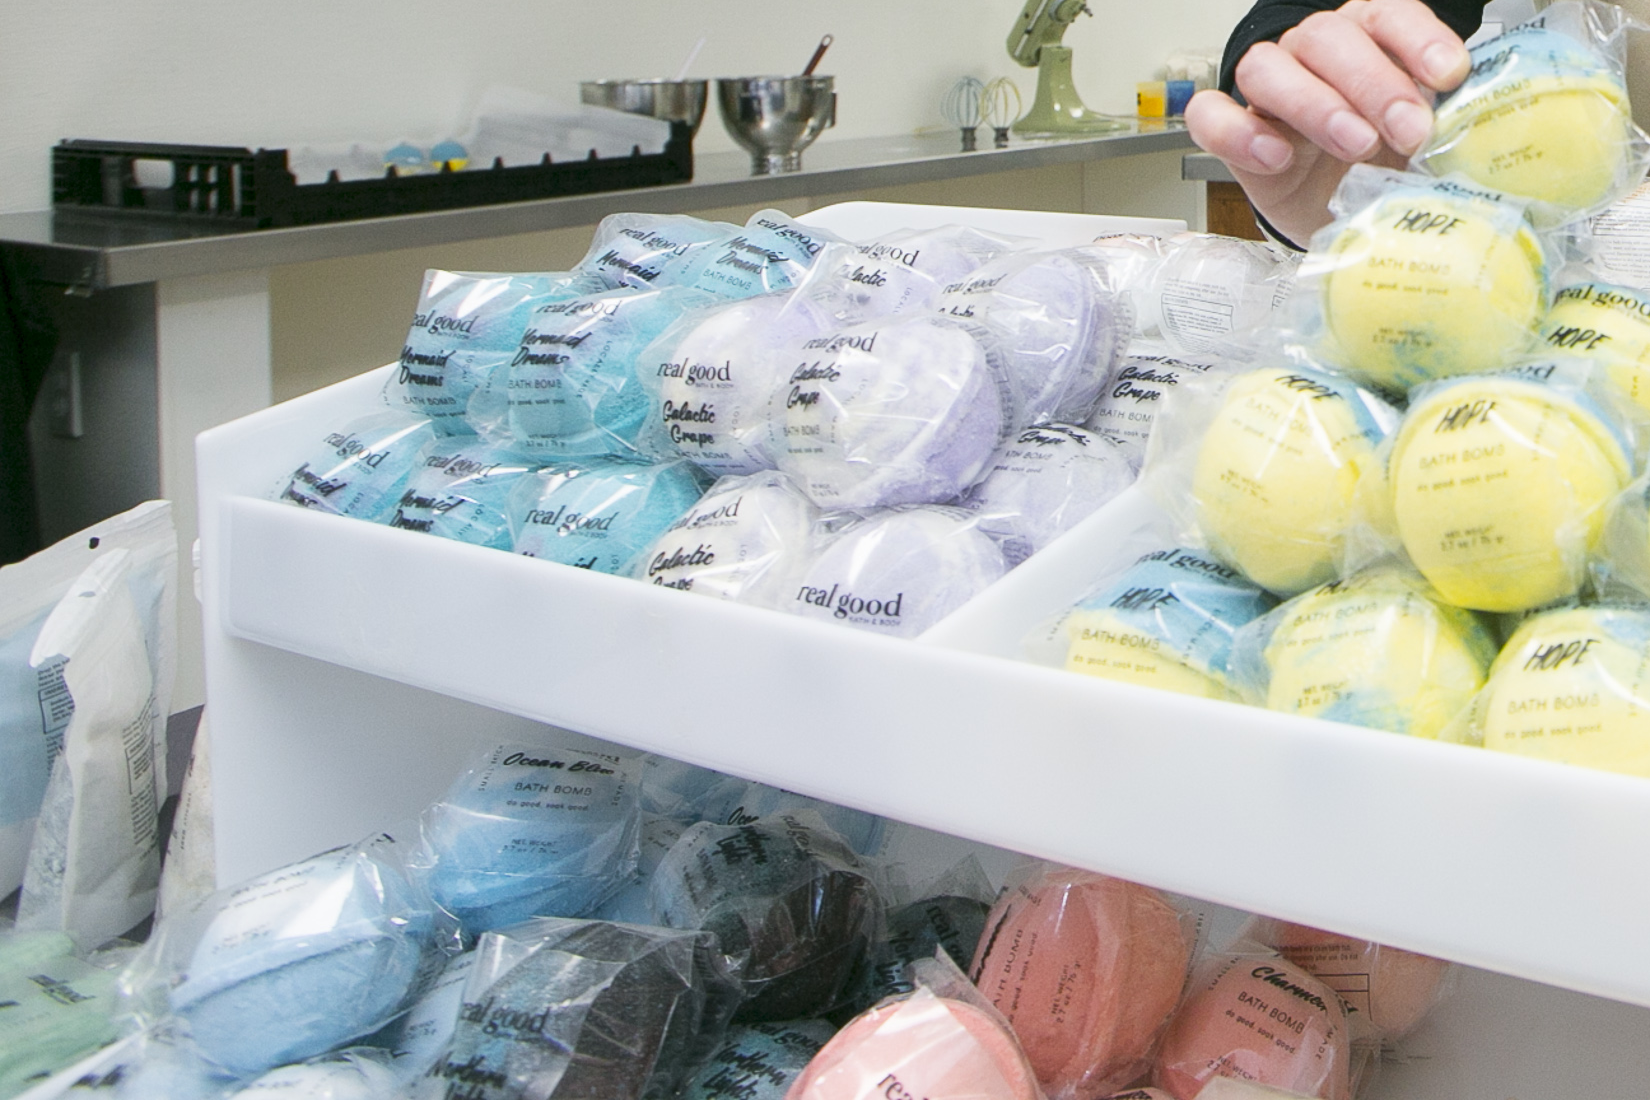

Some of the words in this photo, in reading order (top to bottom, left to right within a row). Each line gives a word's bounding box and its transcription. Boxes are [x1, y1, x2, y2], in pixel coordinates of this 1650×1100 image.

[1393, 208, 1467, 236] HOPE
[1368, 255, 1404, 272] BATH
[1408, 256, 1451, 275] BOMB
[702, 269, 724, 283] BATH
[725, 275, 753, 292] BOMB
[1551, 284, 1595, 311] real
[427, 314, 481, 334] good
[1547, 325, 1612, 350] HOPE
[510, 347, 570, 368] Dreams
[399, 365, 444, 388] Dreams
[508, 378, 532, 389] BATH
[533, 378, 562, 389] BOMB
[656, 357, 690, 378] real
[684, 359, 732, 386] good
[1117, 365, 1180, 386] Galactic
[1111, 380, 1161, 403] Grape
[662, 399, 716, 425] Galactic
[1099, 408, 1125, 419] BATH
[1128, 412, 1155, 423] BOM
[1434, 399, 1497, 434] HOPE
[670, 423, 715, 448] Grape
[1418, 453, 1457, 470] BATH
[1461, 443, 1506, 462] BOMB
[524, 504, 567, 525] real
[556, 511, 619, 538] good
[648, 544, 715, 577] Galactic
[1170, 552, 1241, 580] good
[796, 583, 839, 609] real
[833, 592, 904, 620] good
[1081, 628, 1116, 645] BATH
[1119, 631, 1161, 652] BOMB
[1523, 638, 1601, 671] HOPE
[1507, 697, 1548, 715] BATH
[1553, 694, 1601, 711] BOMB
[503, 752, 566, 770] Ocean
[514, 782, 549, 793] BATH
[553, 785, 593, 797] BOMB
[993, 974, 1008, 1009] ATH
[1003, 928, 1024, 973] BOMB
[1237, 990, 1269, 1015] BATH
[1268, 1005, 1306, 1035] BOMB
